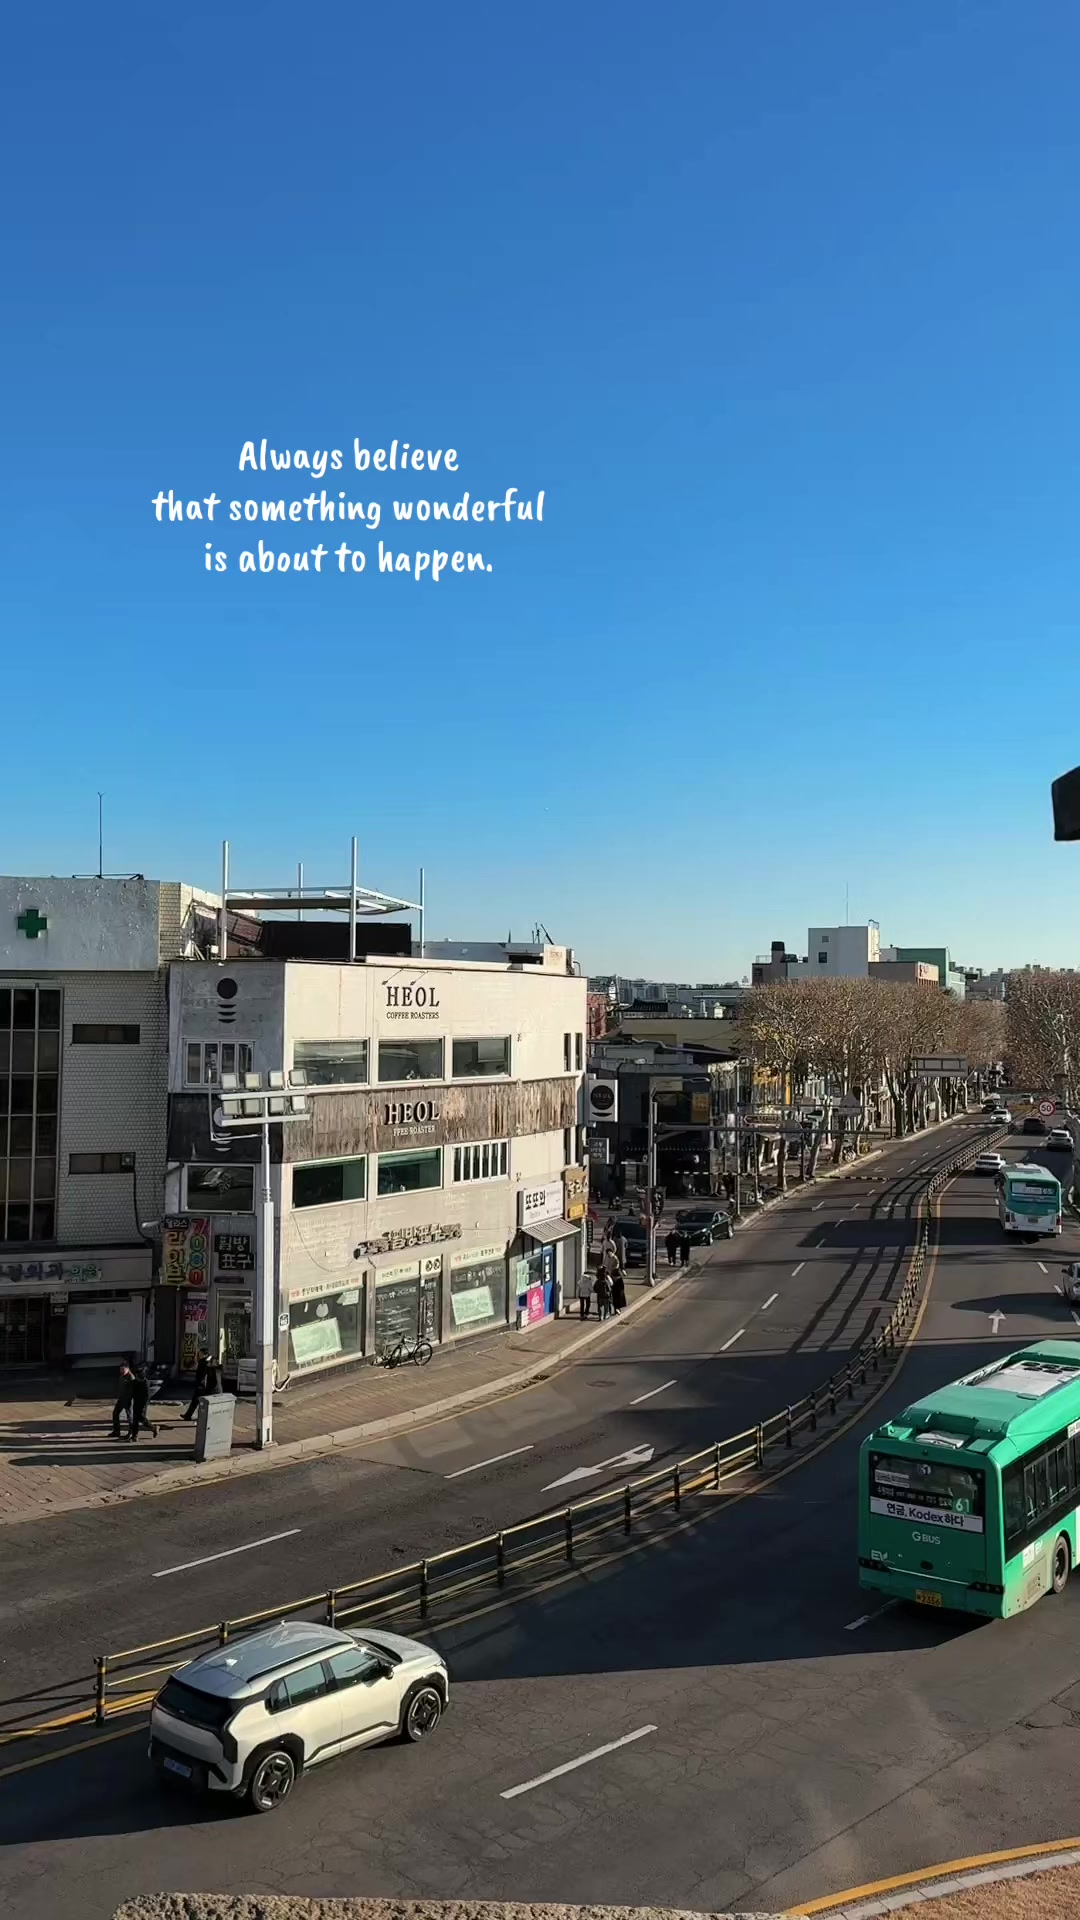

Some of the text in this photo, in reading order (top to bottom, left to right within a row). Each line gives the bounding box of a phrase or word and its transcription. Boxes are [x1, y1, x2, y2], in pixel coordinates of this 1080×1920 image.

[386, 986, 440, 1007] HEOL
[410, 1012, 440, 1020] ROASTERS
[385, 1101, 441, 1125] HEOL
[1042, 1104, 1052, 1112] 50
[221, 1253, 252, 1269] 표구
[955, 1497, 970, 1512] 61
